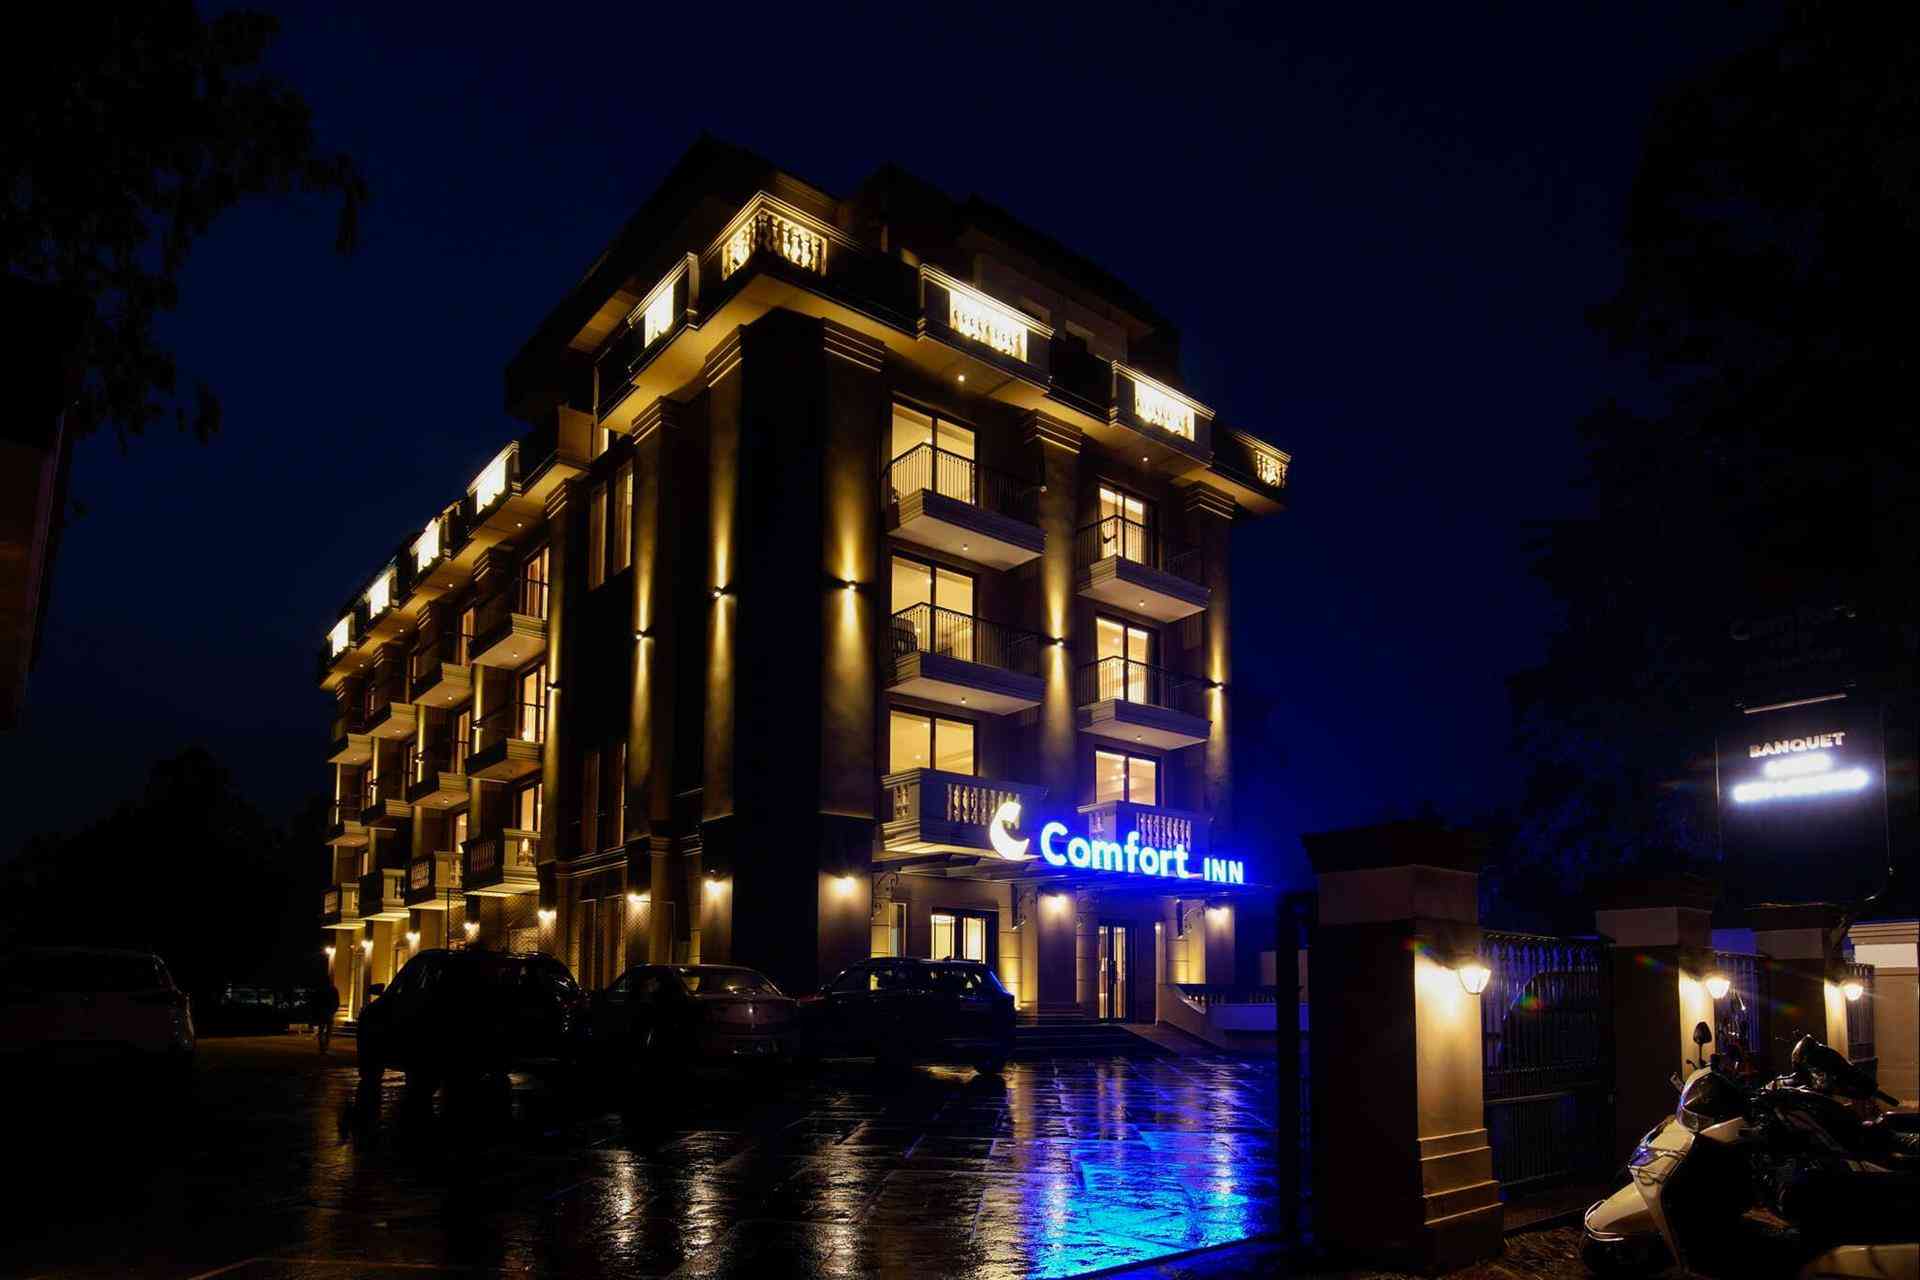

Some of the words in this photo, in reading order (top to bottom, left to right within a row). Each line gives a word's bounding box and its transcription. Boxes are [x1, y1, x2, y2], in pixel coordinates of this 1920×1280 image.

[1749, 732, 1846, 758] BANQUET
[1040, 822, 1189, 879] Comfort
[1203, 857, 1244, 884] INN
